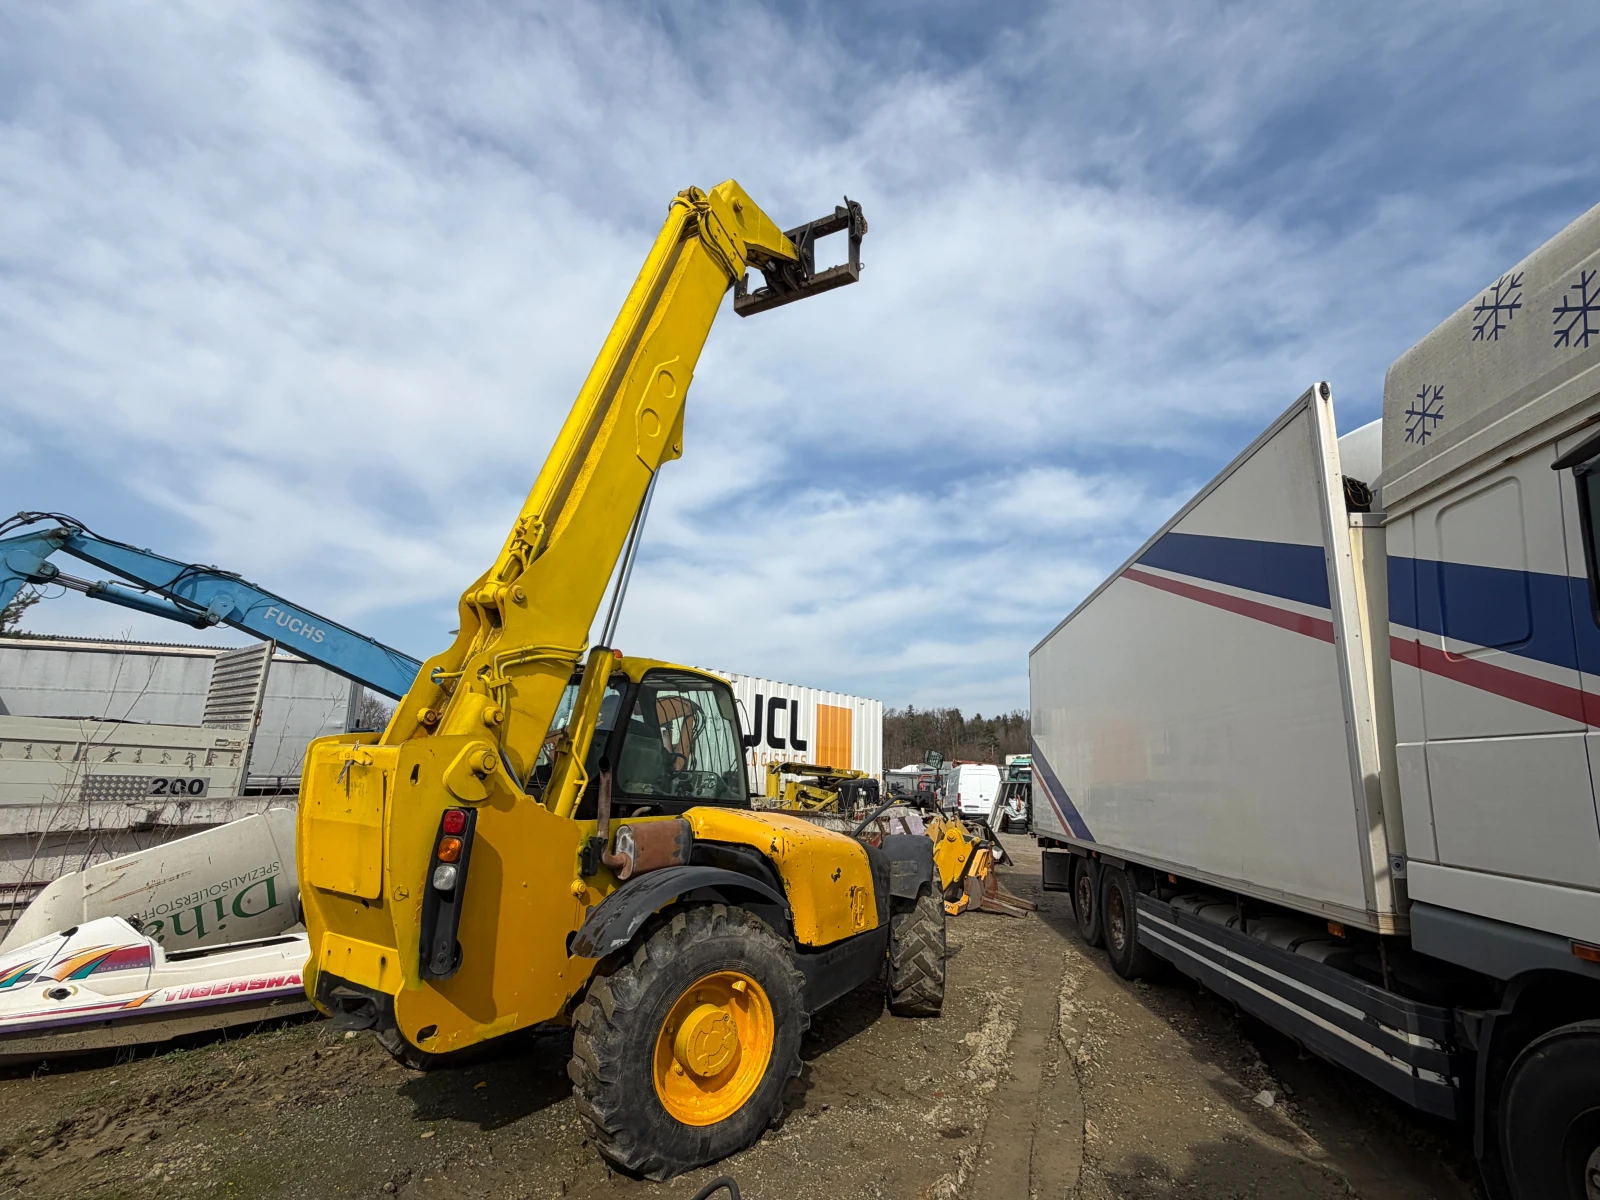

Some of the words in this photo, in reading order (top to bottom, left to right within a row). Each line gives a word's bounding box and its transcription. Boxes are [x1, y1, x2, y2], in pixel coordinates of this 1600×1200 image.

[264, 606, 326, 643] FUCHS
[743, 693, 807, 751] JCL
[746, 751, 807, 767] OGISTICS
[150, 778, 204, 795] 200
[101, 963, 144, 972] DAYTONA
